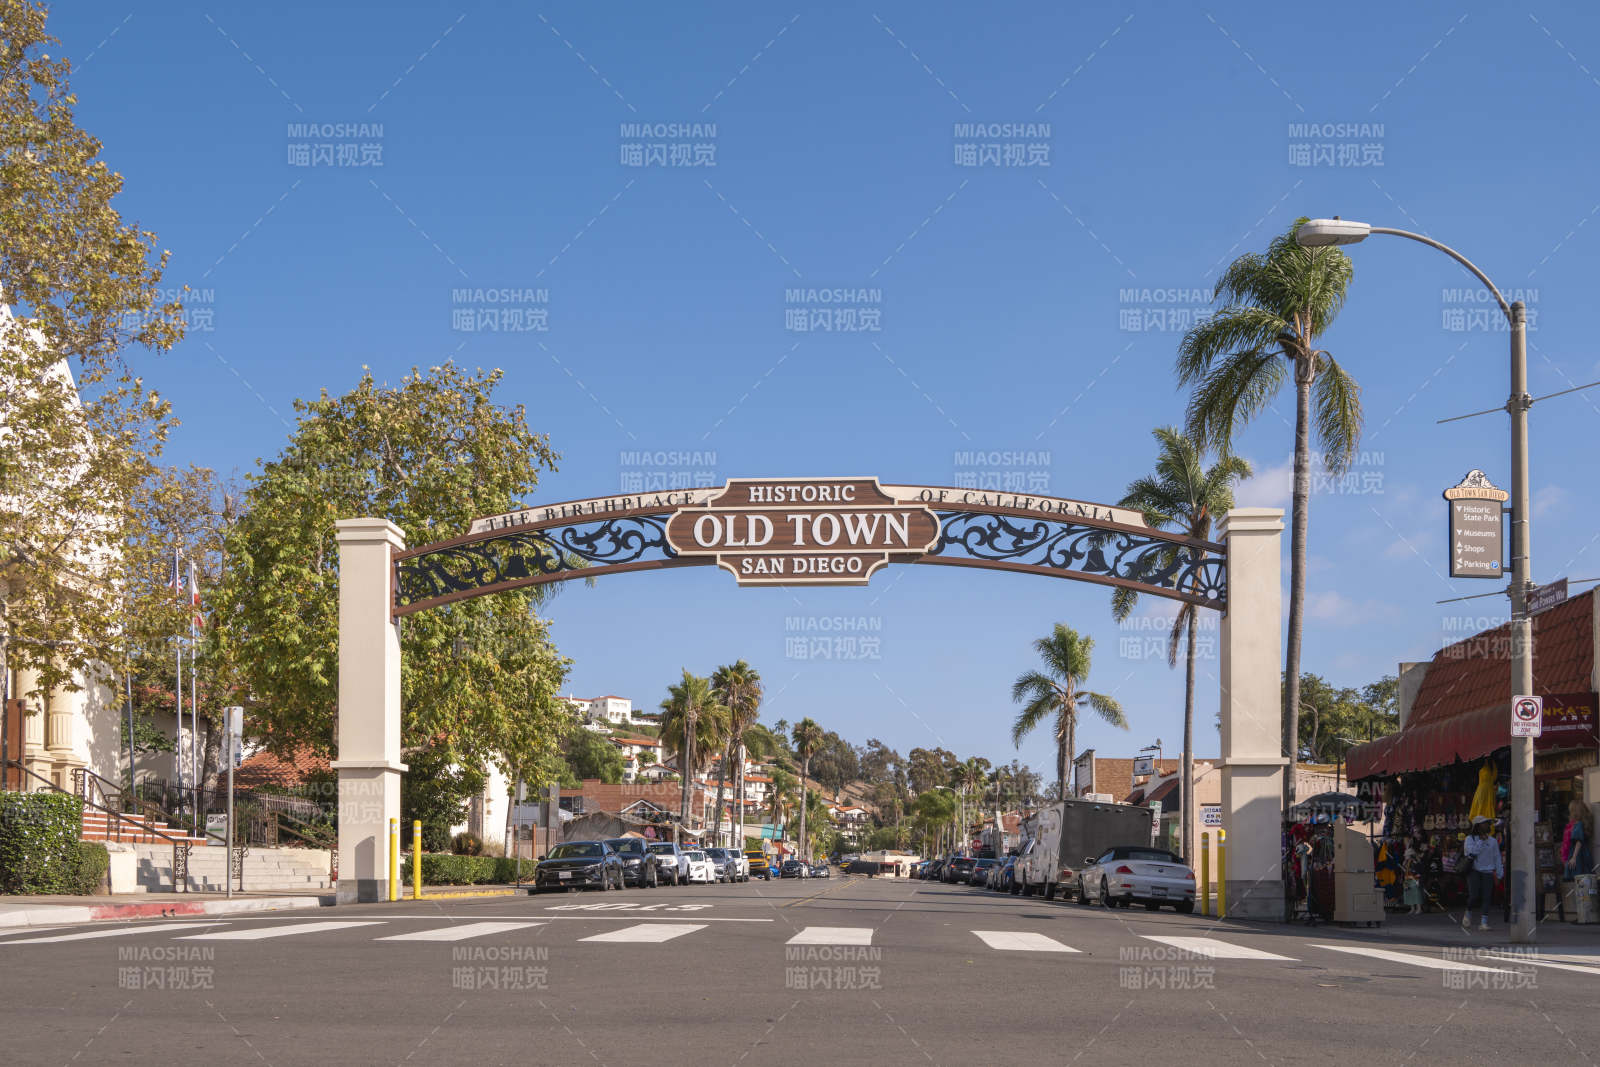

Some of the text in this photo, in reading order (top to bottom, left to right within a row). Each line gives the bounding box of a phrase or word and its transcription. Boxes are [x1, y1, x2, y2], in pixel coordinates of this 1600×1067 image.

[749, 485, 856, 503] HISTORIC
[1450, 489, 1460, 499] OLD
[1461, 488, 1476, 498] TOWN
[1489, 490, 1505, 500] DIEGO
[486, 491, 695, 532] THE BIRTHPLACE
[920, 488, 1115, 523] OF CALIFORNIA
[1463, 505, 1491, 513] Historic
[1463, 513, 1499, 522] State Park
[693, 513, 911, 547] OLD TOWN
[1463, 529, 1496, 537] Museums
[1463, 544, 1485, 554] Shops
[741, 556, 863, 574] SAN DIEGO
[1463, 560, 1490, 570] Parking
